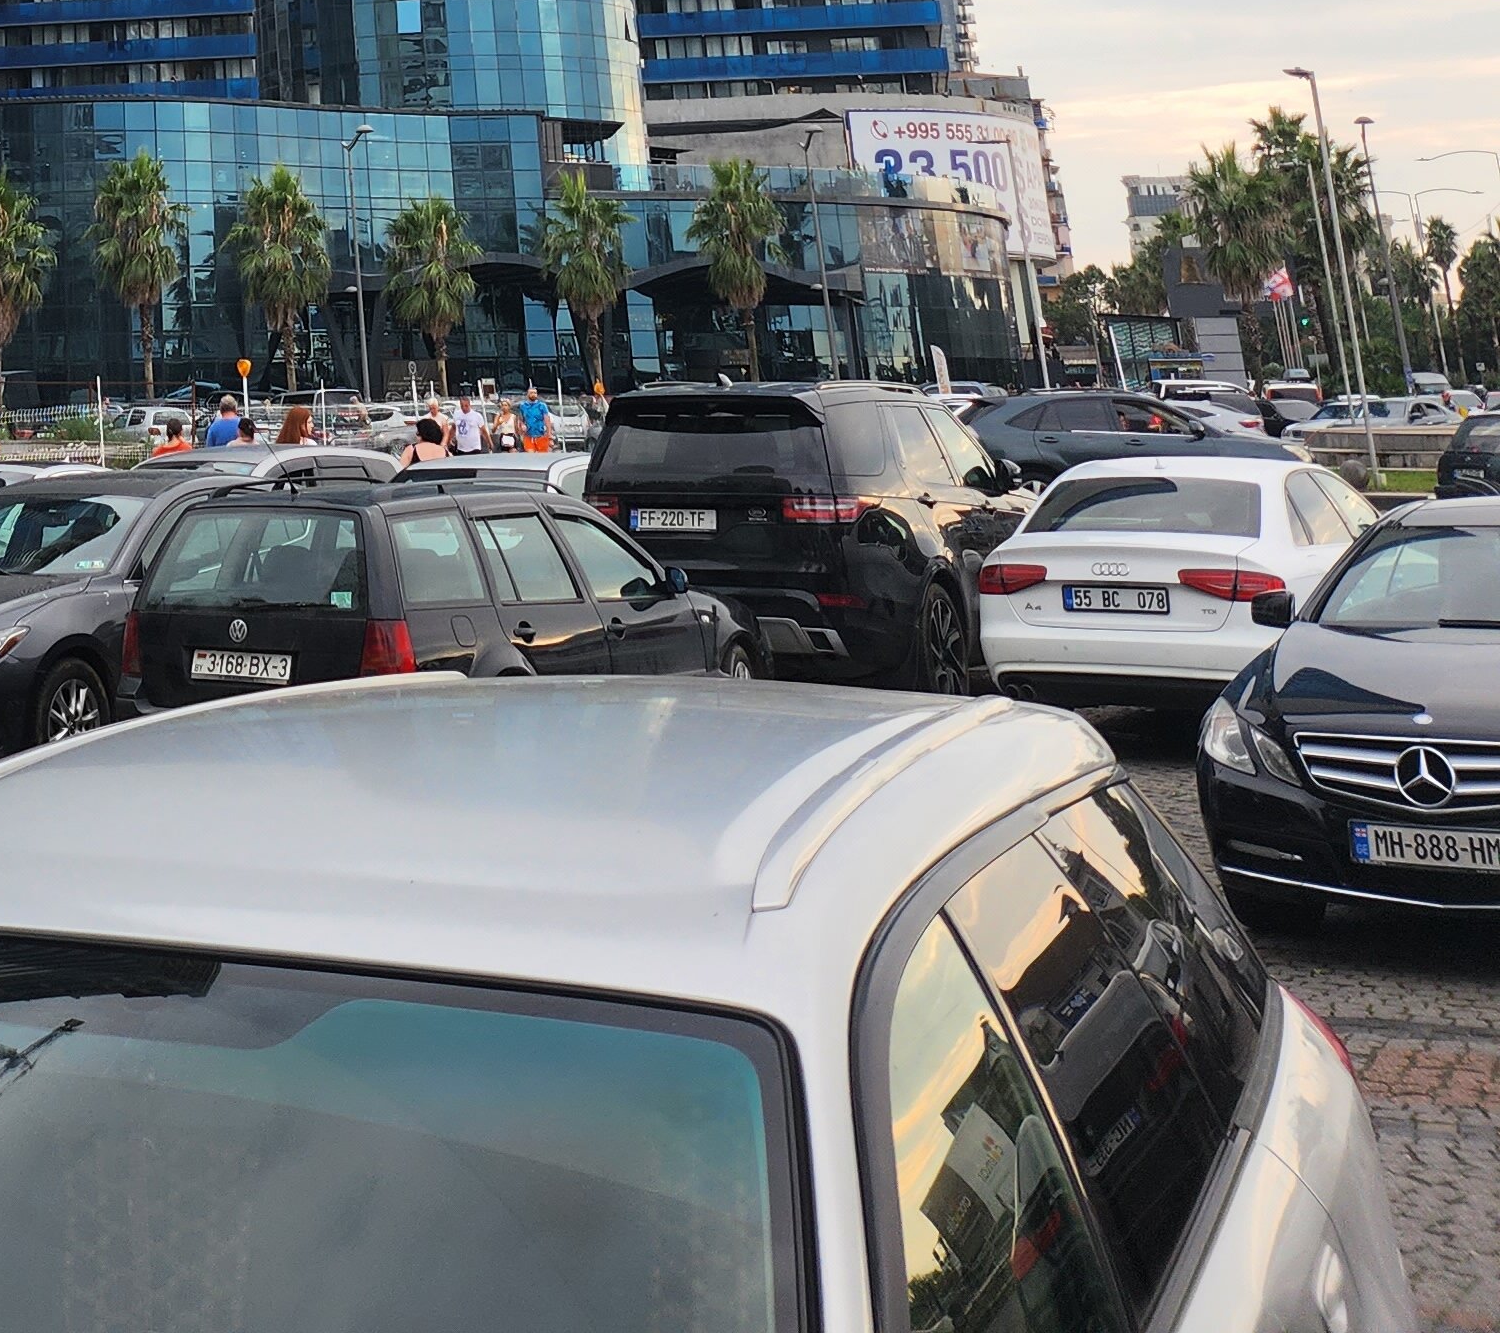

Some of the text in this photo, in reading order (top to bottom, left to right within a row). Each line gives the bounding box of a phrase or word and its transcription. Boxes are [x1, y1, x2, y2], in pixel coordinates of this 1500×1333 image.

[894, 121, 940, 139] +995
[945, 123, 973, 141] 555
[950, 149, 1008, 192] 500
[640, 511, 706, 527] FF-220-TF
[1074, 589, 1166, 609] 55 BC 078
[207, 653, 245, 674] 3168
[1373, 829, 1500, 865] MH-888-HM
